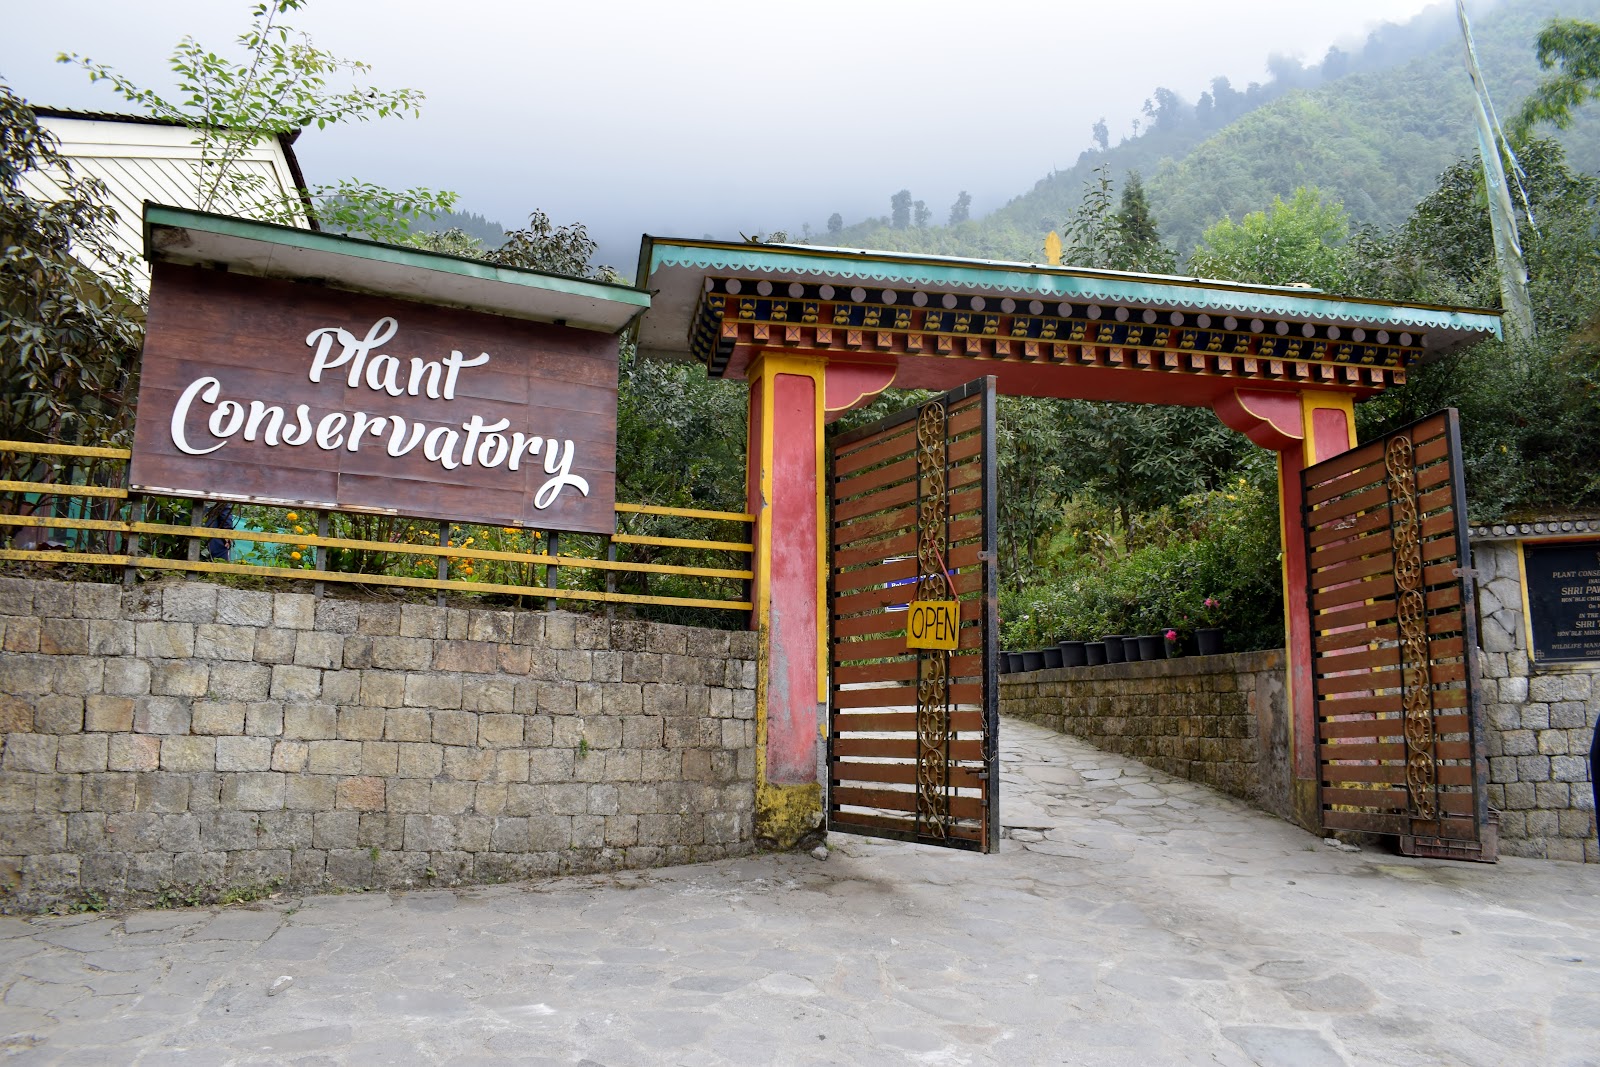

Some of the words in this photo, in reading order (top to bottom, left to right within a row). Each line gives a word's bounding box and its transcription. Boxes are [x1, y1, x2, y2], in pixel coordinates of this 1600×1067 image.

[306, 316, 490, 400] Plant
[170, 376, 590, 510] Conservatory
[1561, 586, 1583, 595] SHRI
[911, 606, 957, 641] OPEN
[1575, 620, 1595, 628] SHRI
